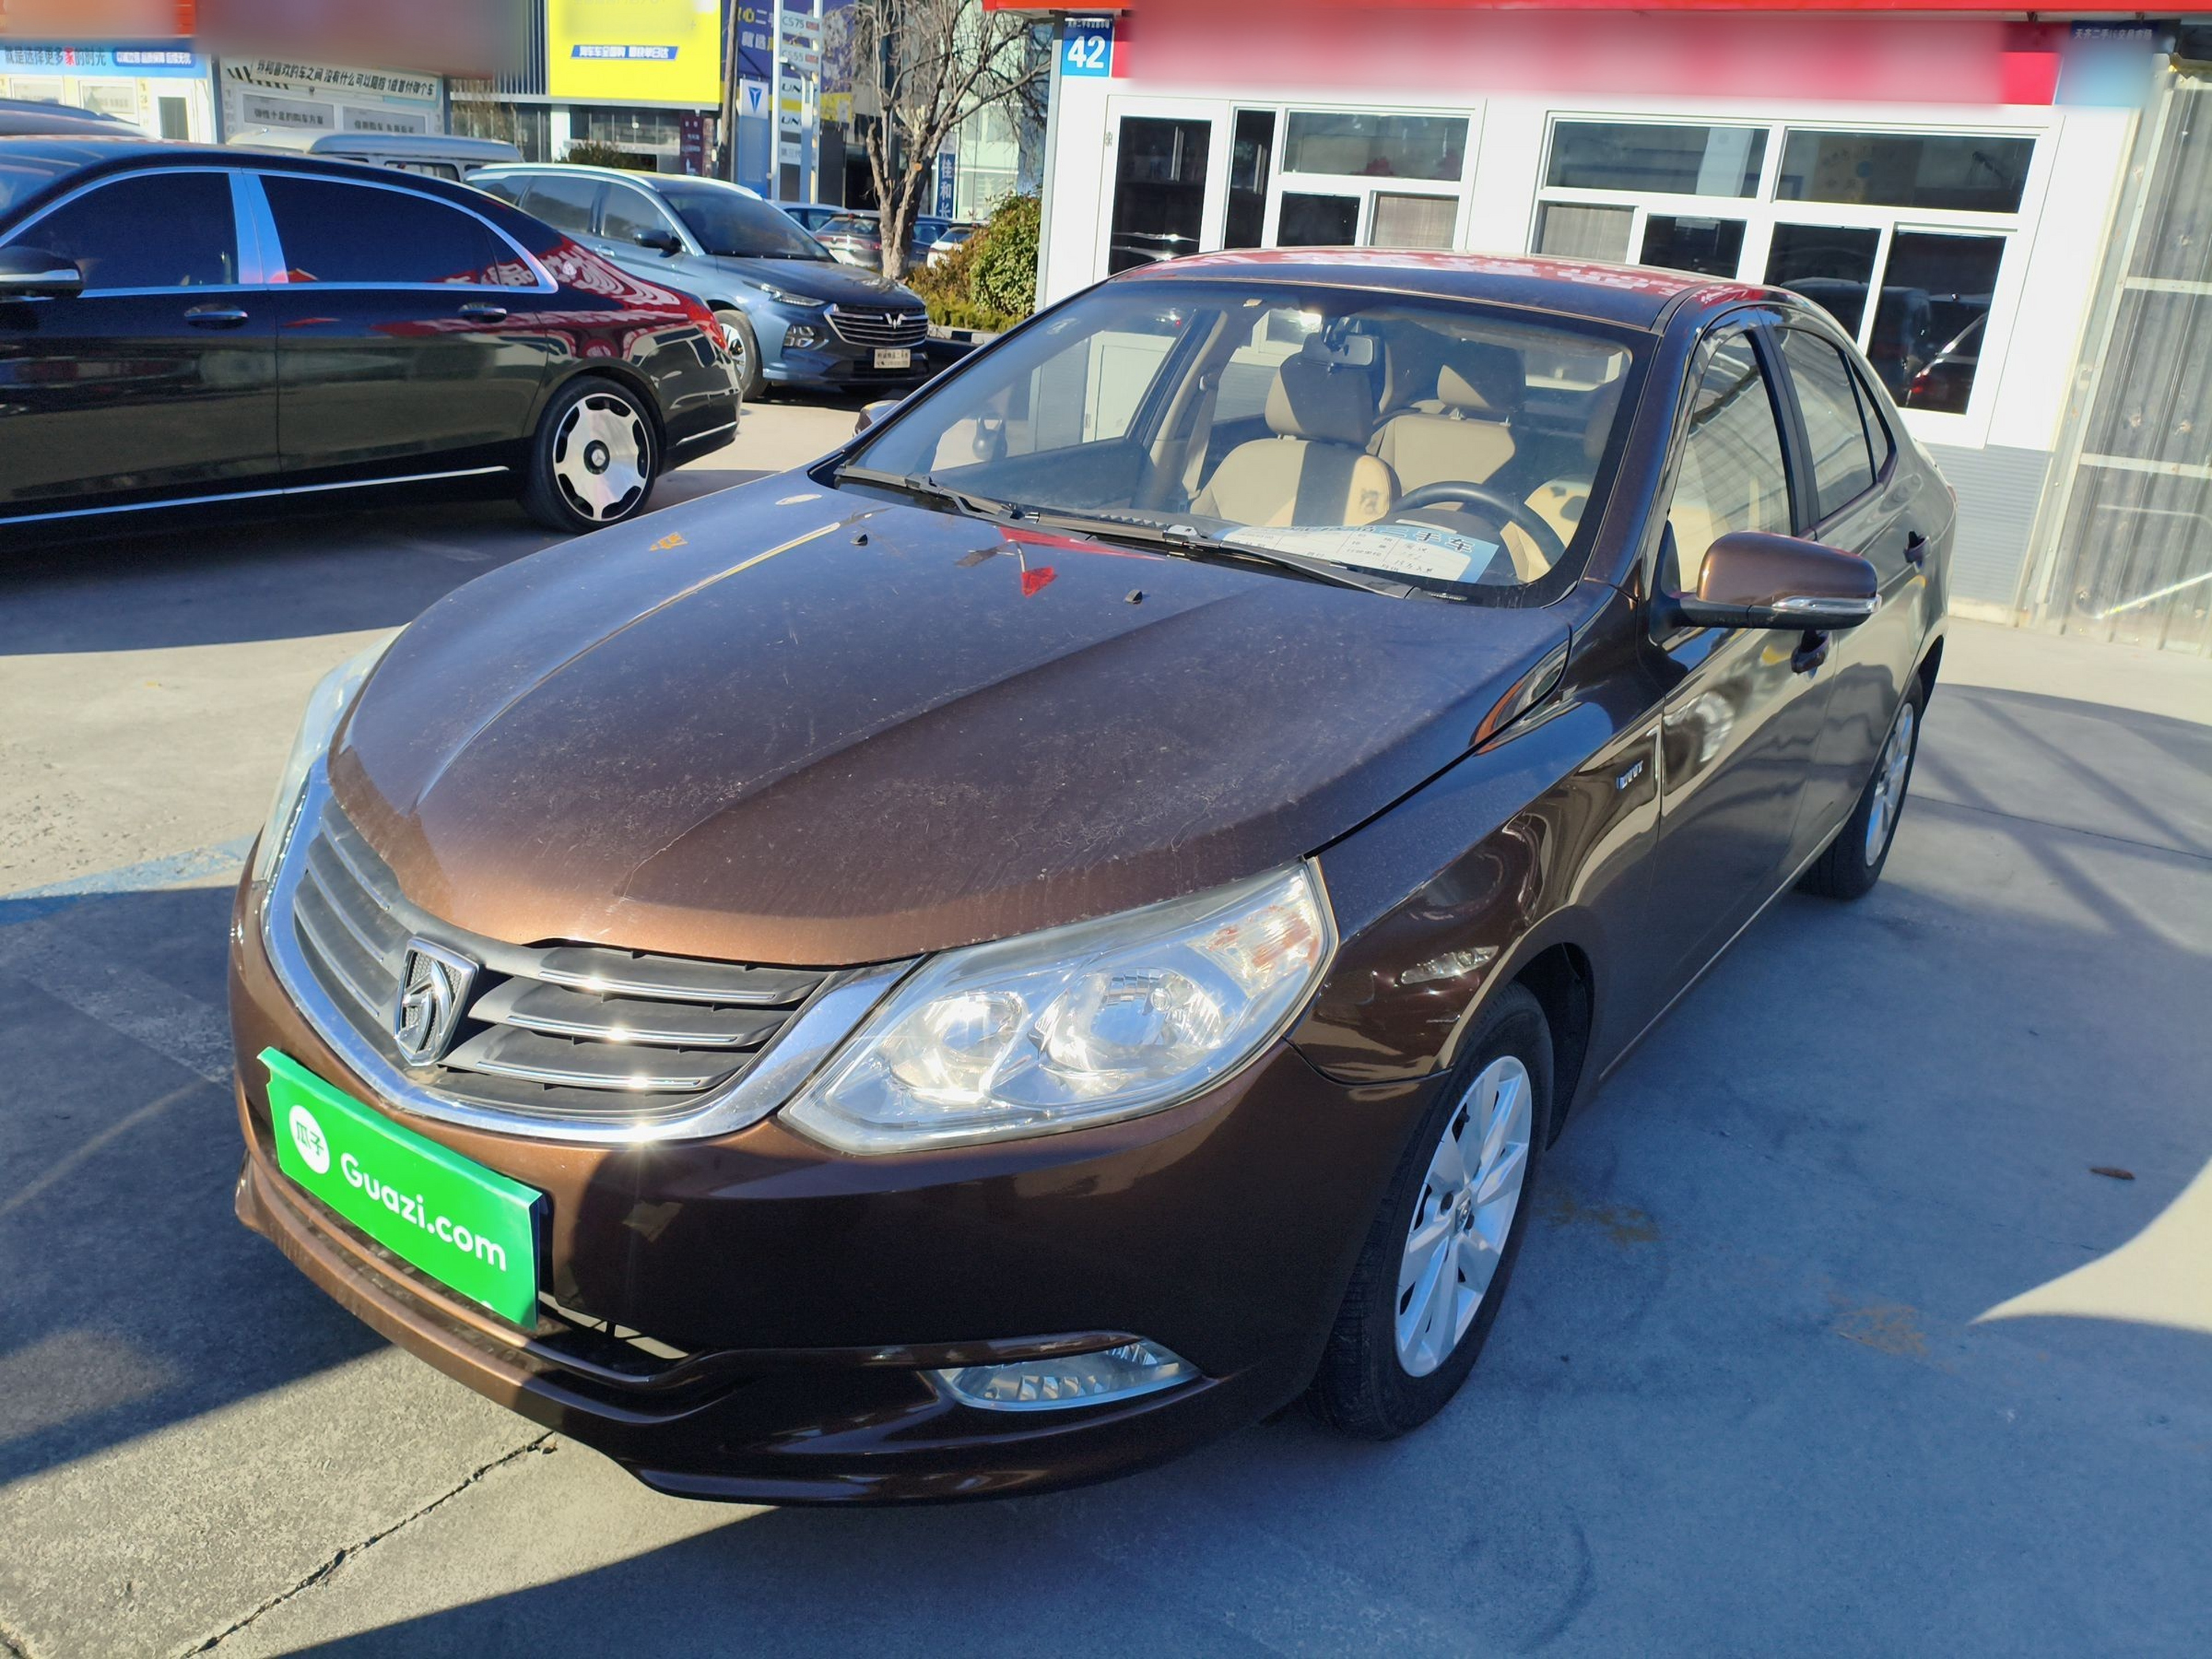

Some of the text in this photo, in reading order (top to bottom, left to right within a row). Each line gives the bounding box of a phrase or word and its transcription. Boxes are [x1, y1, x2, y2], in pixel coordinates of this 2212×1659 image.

[1067, 36, 1105, 68] 42
[296, 1120, 324, 1156] 瓜子
[340, 1153, 507, 1271] Guazi.com
